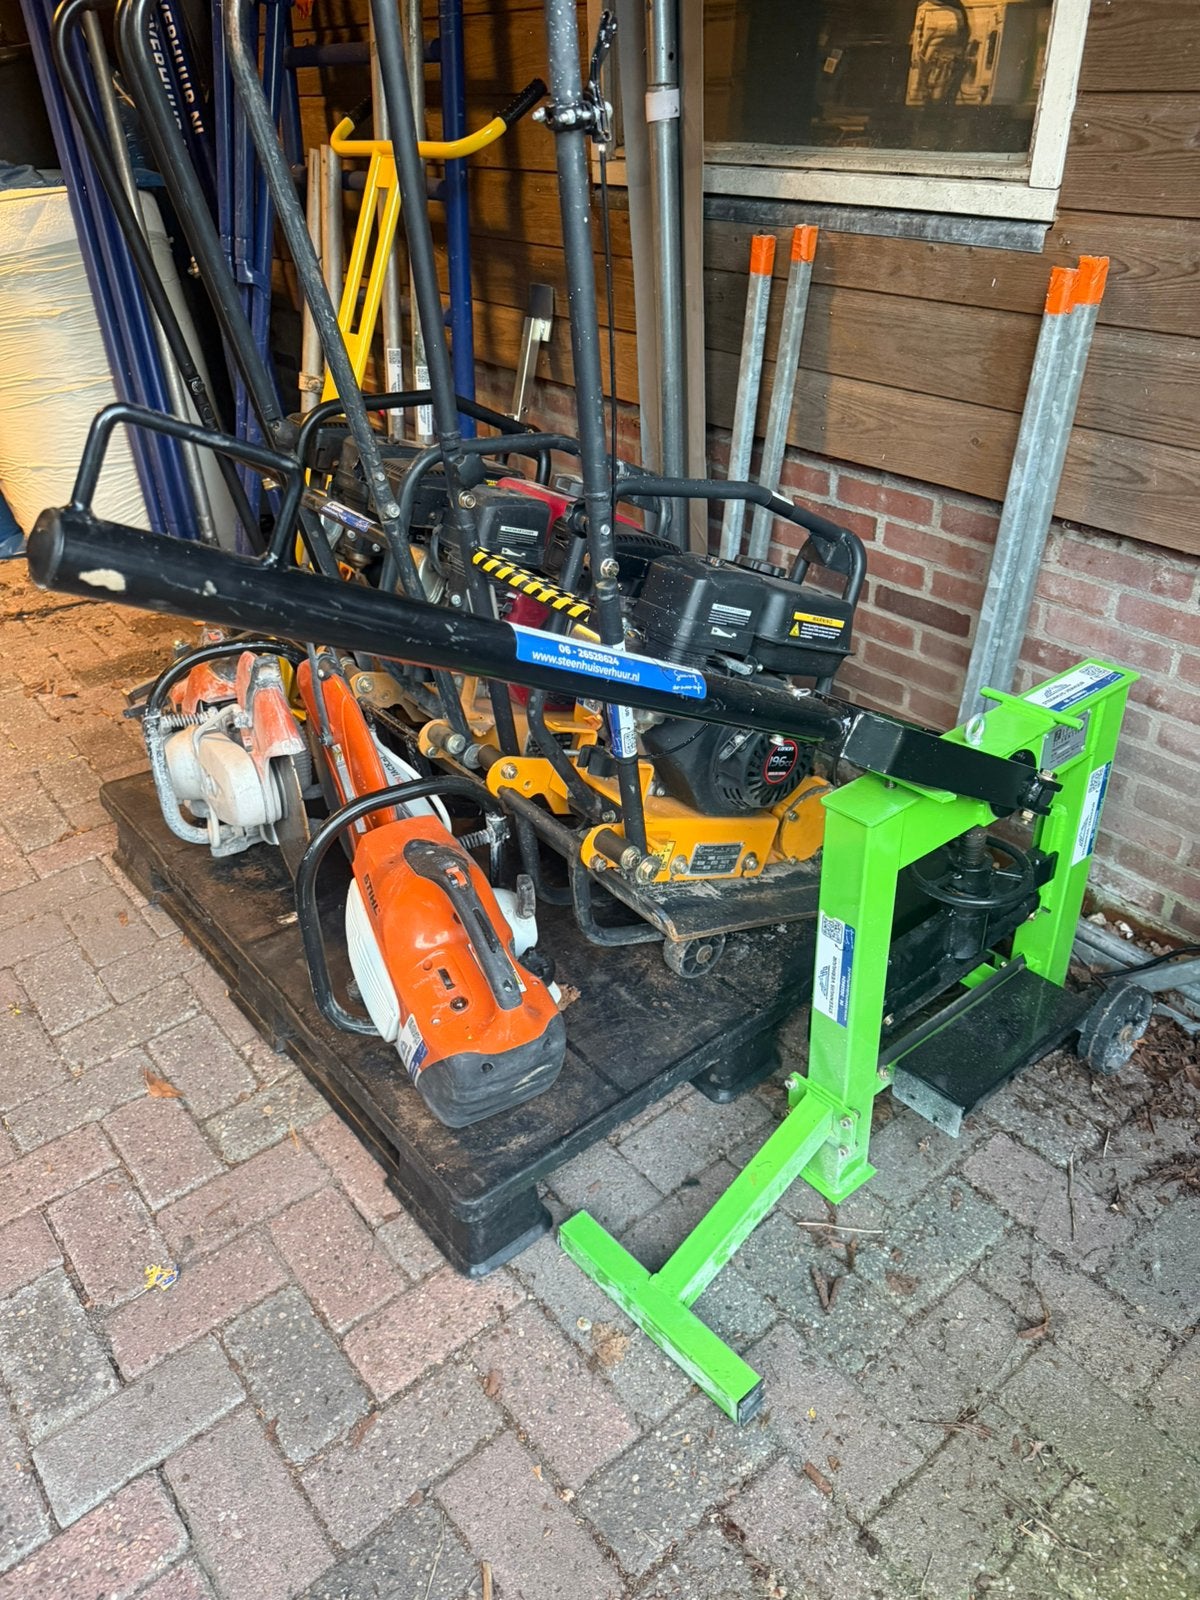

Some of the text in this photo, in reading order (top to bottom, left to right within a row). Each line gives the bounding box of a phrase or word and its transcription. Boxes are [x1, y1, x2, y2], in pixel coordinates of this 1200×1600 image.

[532, 650, 640, 683] www.steenhuisverhuur.nl
[558, 643, 570, 656] 06
[577, 647, 620, 666] 26528624
[363, 873, 380, 917] STIHL
